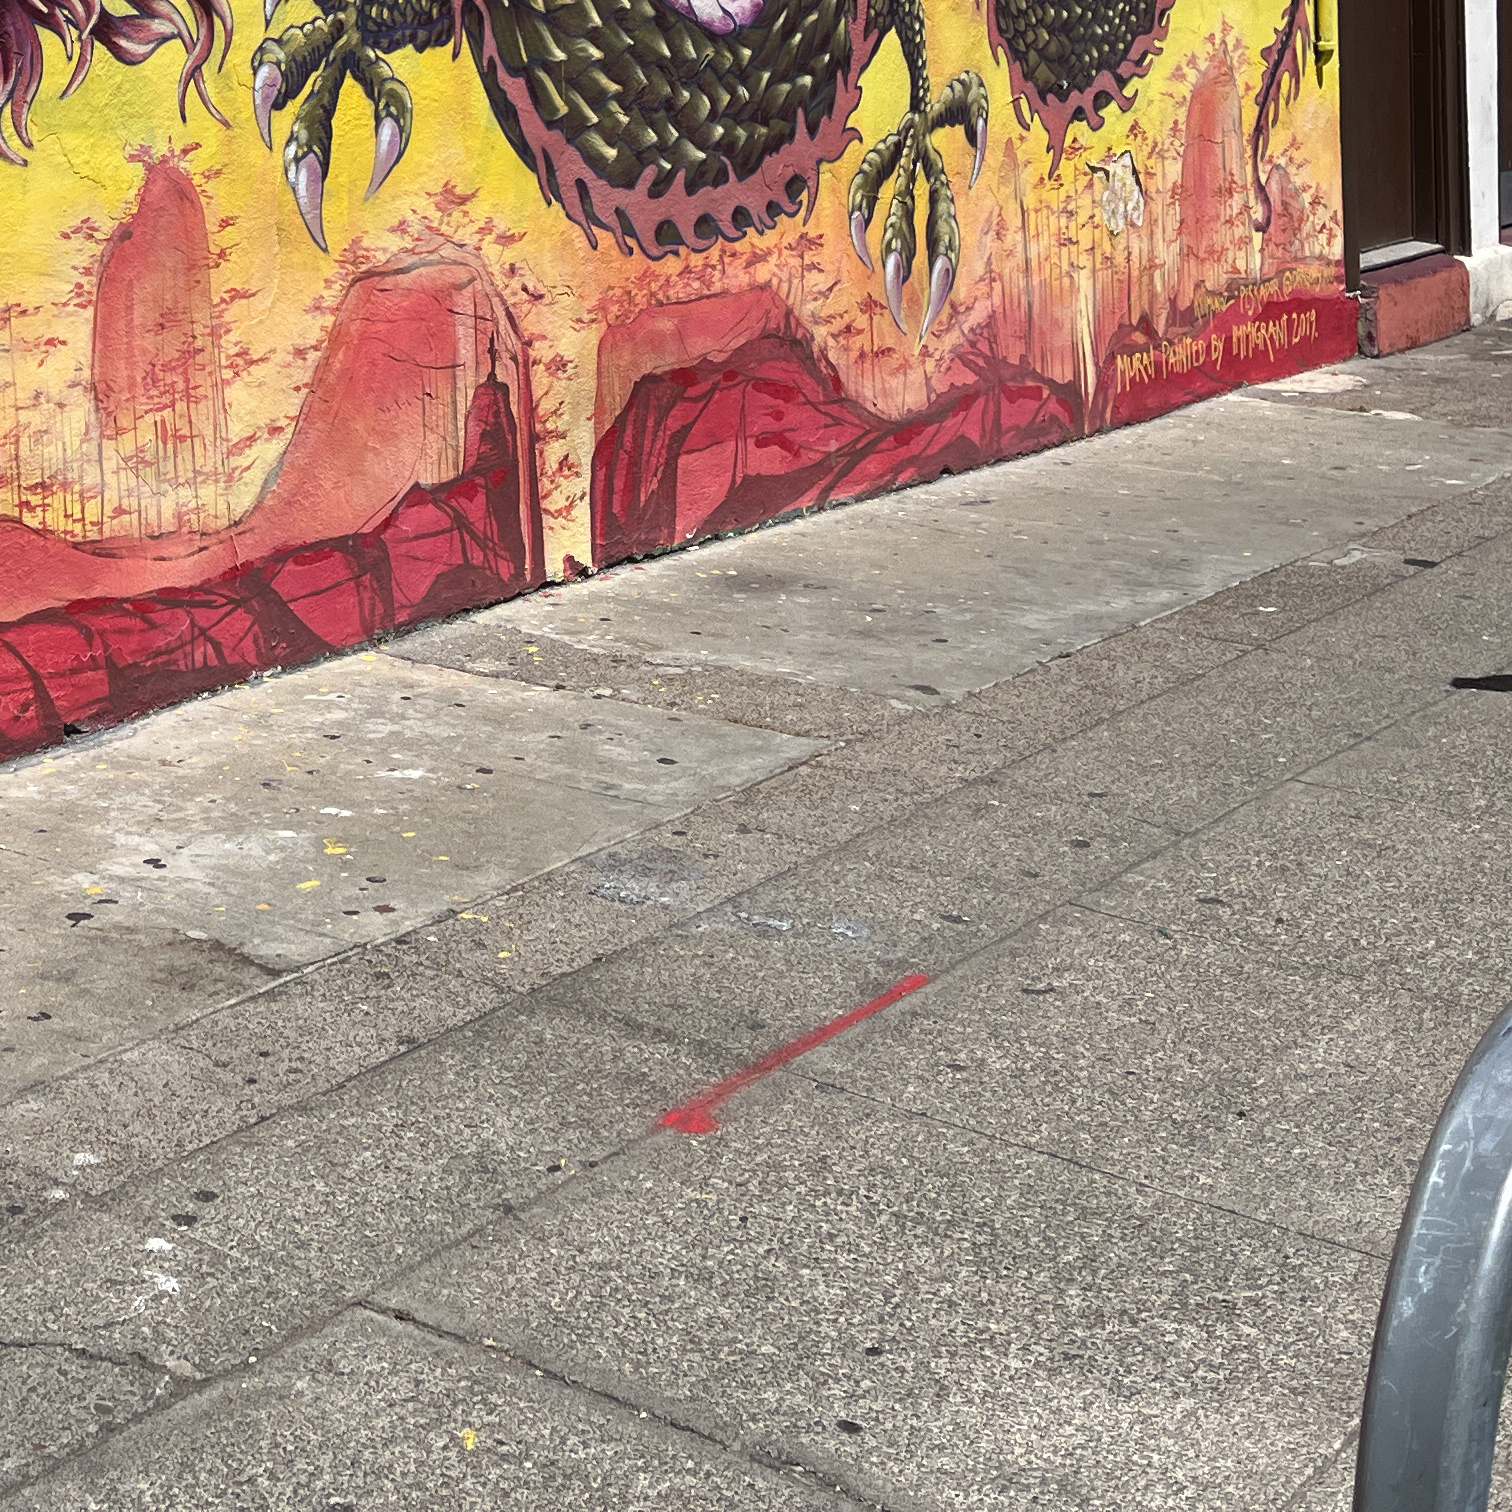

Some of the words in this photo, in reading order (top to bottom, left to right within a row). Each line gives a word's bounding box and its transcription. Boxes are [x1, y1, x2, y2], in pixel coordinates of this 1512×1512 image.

[1161, 336, 1207, 380] PAINTED
[1211, 333, 1226, 371] BY
[1232, 312, 1289, 363] IMMIGRANT
